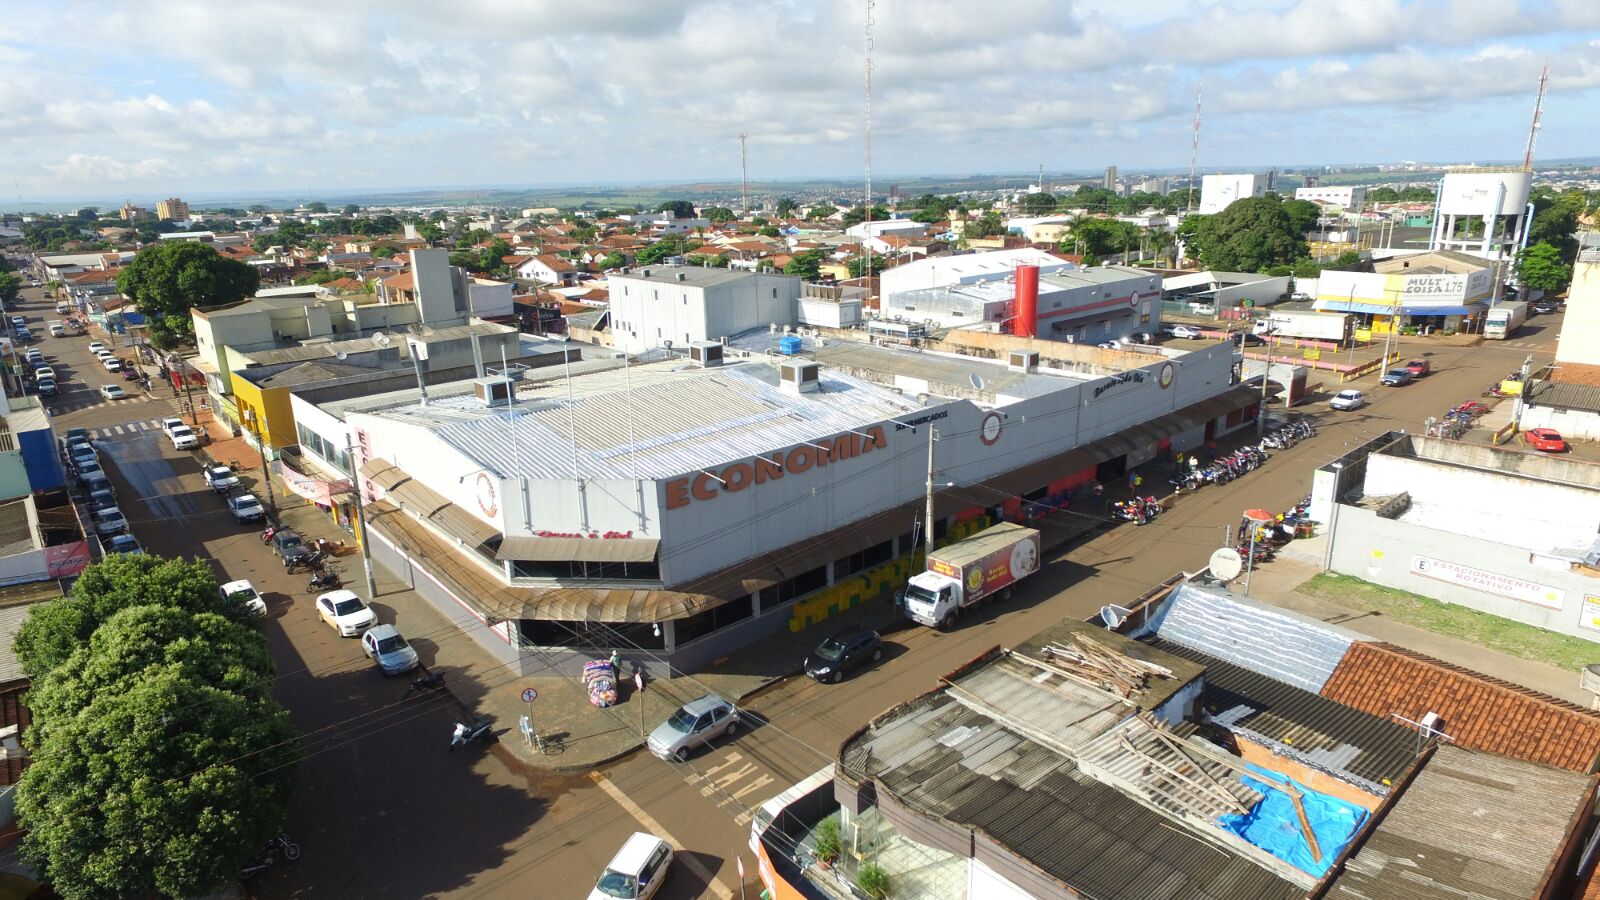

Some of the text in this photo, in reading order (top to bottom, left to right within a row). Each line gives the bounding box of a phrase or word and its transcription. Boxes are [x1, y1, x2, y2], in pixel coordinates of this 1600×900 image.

[1406, 286, 1442, 294] COISA
[665, 424, 887, 511] ECONOMIA
[1432, 561, 1541, 592] ESTACIONAMENTO
[1455, 573, 1513, 592] ROTATIVO
